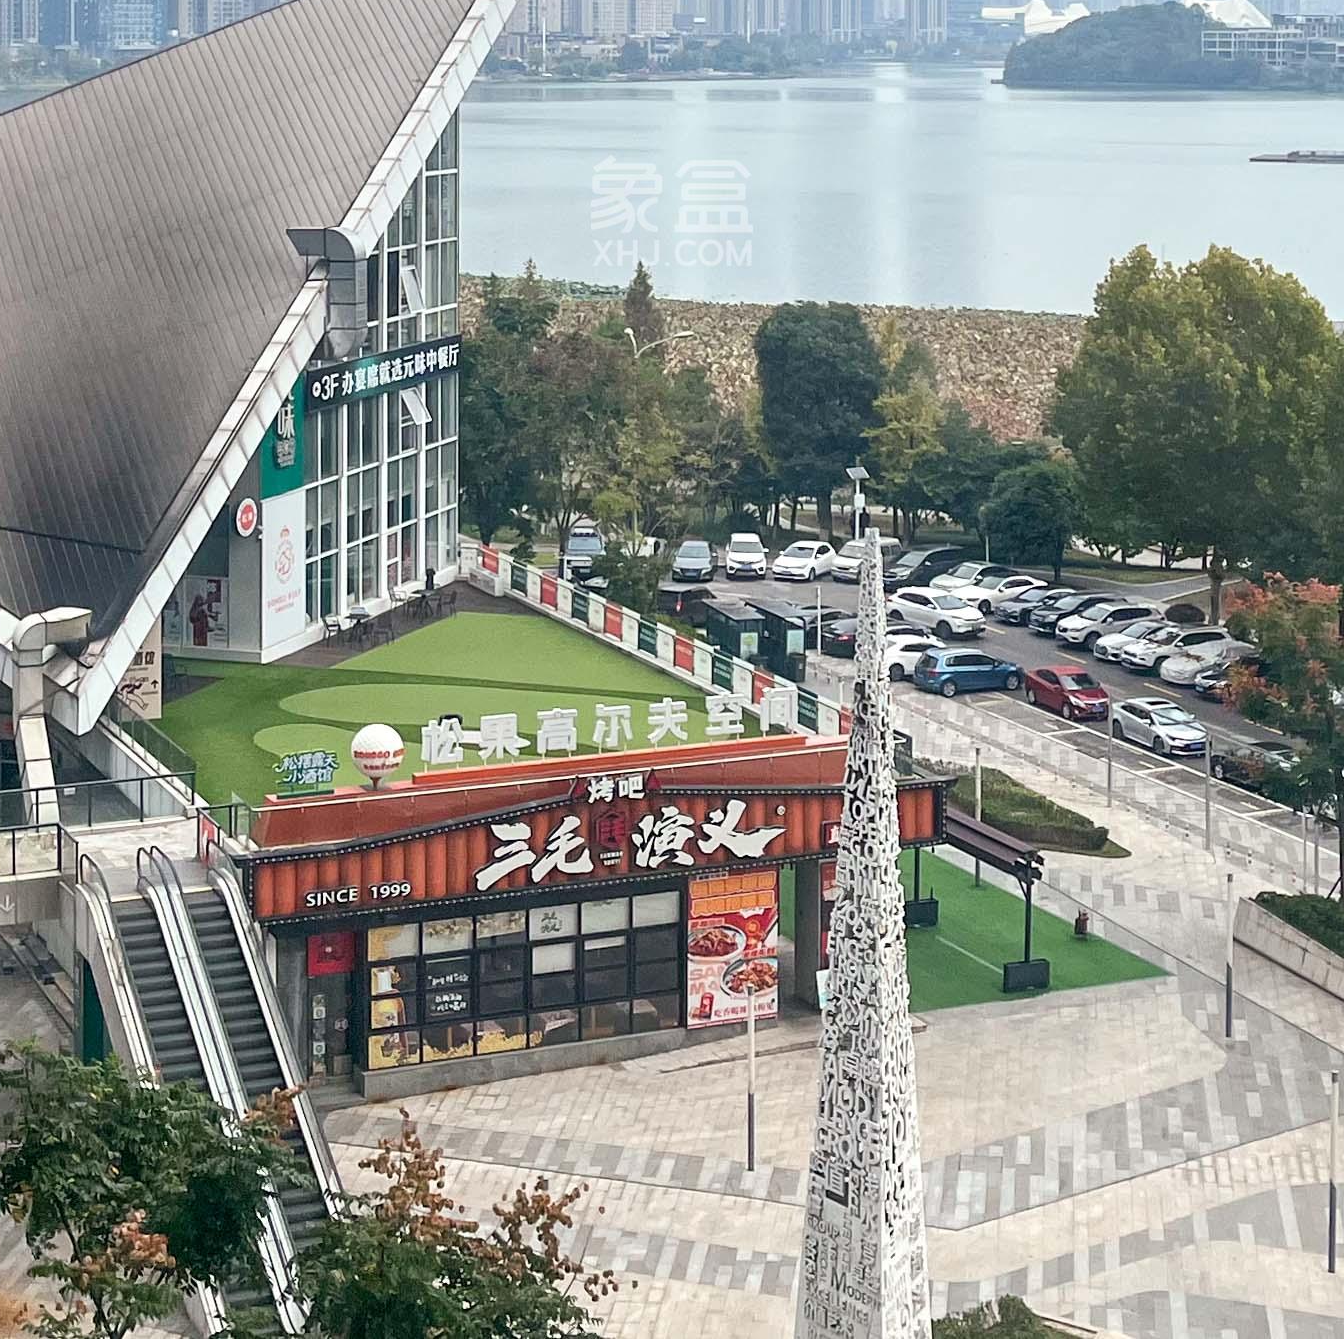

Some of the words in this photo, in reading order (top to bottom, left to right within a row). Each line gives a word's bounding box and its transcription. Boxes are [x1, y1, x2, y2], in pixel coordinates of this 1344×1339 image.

[421, 685, 798, 764] 松果高尔夫空间
[587, 773, 646, 804] 烤吧
[306, 887, 359, 907] SINCE
[370, 882, 411, 899] 1999
